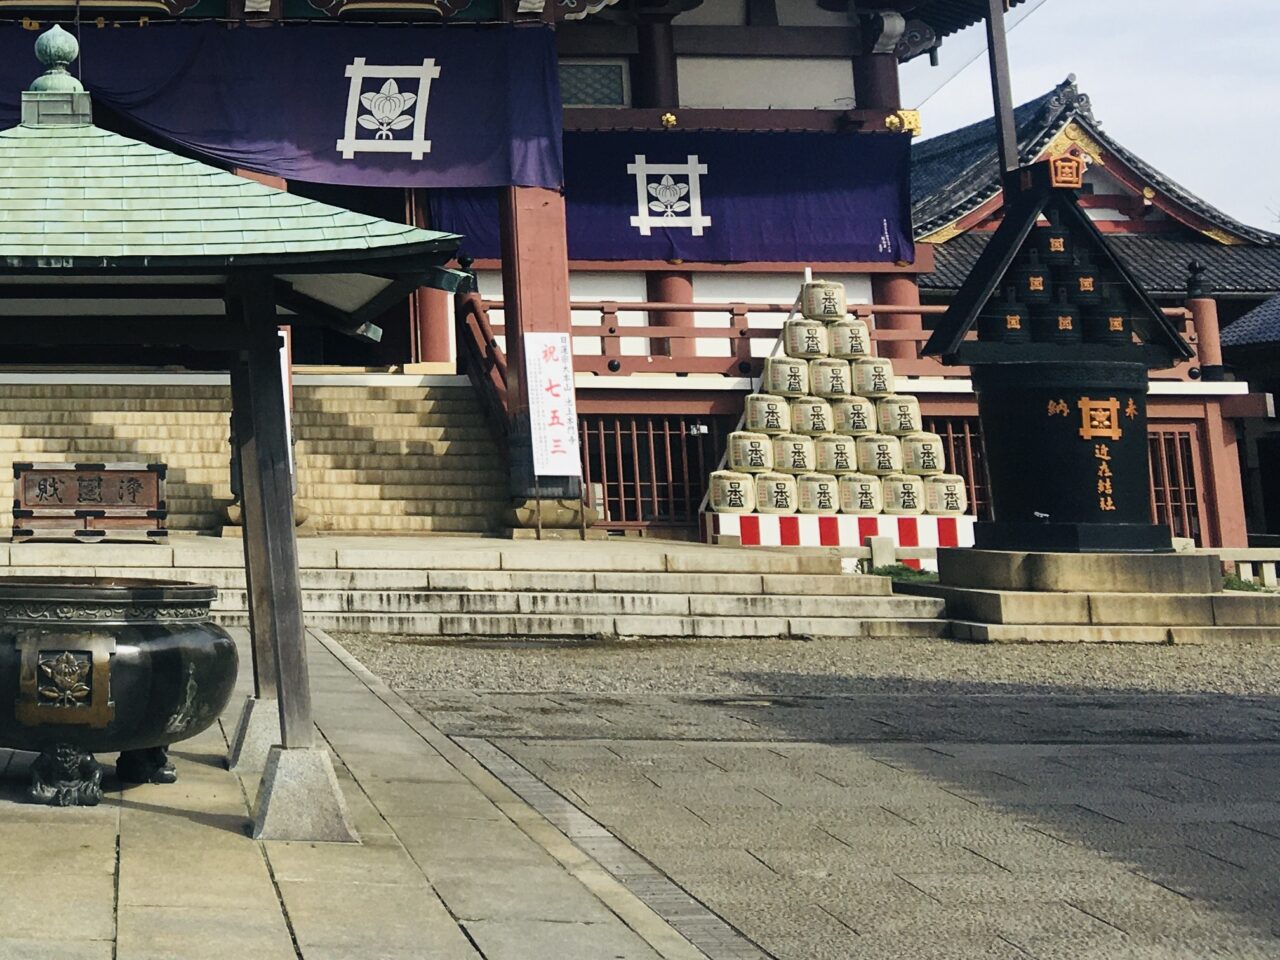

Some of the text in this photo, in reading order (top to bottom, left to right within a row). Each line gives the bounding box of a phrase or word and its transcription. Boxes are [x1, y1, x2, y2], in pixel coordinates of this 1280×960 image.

[822, 289, 837, 315] 日本盛
[805, 329, 821, 353] 日本盛
[849, 328, 864, 353] 日本盛
[786, 367, 801, 391] 日本盛
[830, 369, 844, 393] 日本盛
[872, 367, 887, 391] 日本盛
[765, 404, 780, 428] 日本盛
[810, 405, 825, 430] 日本盛
[851, 404, 867, 430] 日本盛
[898, 405, 912, 430] 日本盛
[748, 441, 764, 466] 日本盛
[792, 443, 807, 469] 日本盛
[834, 444, 849, 469] 日本盛
[876, 444, 892, 470] 日本盛
[921, 443, 936, 469] 日本盛
[1094, 443, 1116, 511] 近在結社
[728, 483, 744, 507] 日本盛
[773, 483, 789, 508] 日本盛
[817, 484, 832, 509] 日本盛
[858, 484, 874, 509] 日本盛
[901, 483, 916, 508] 日本盛
[945, 485, 959, 510] 日本盛
